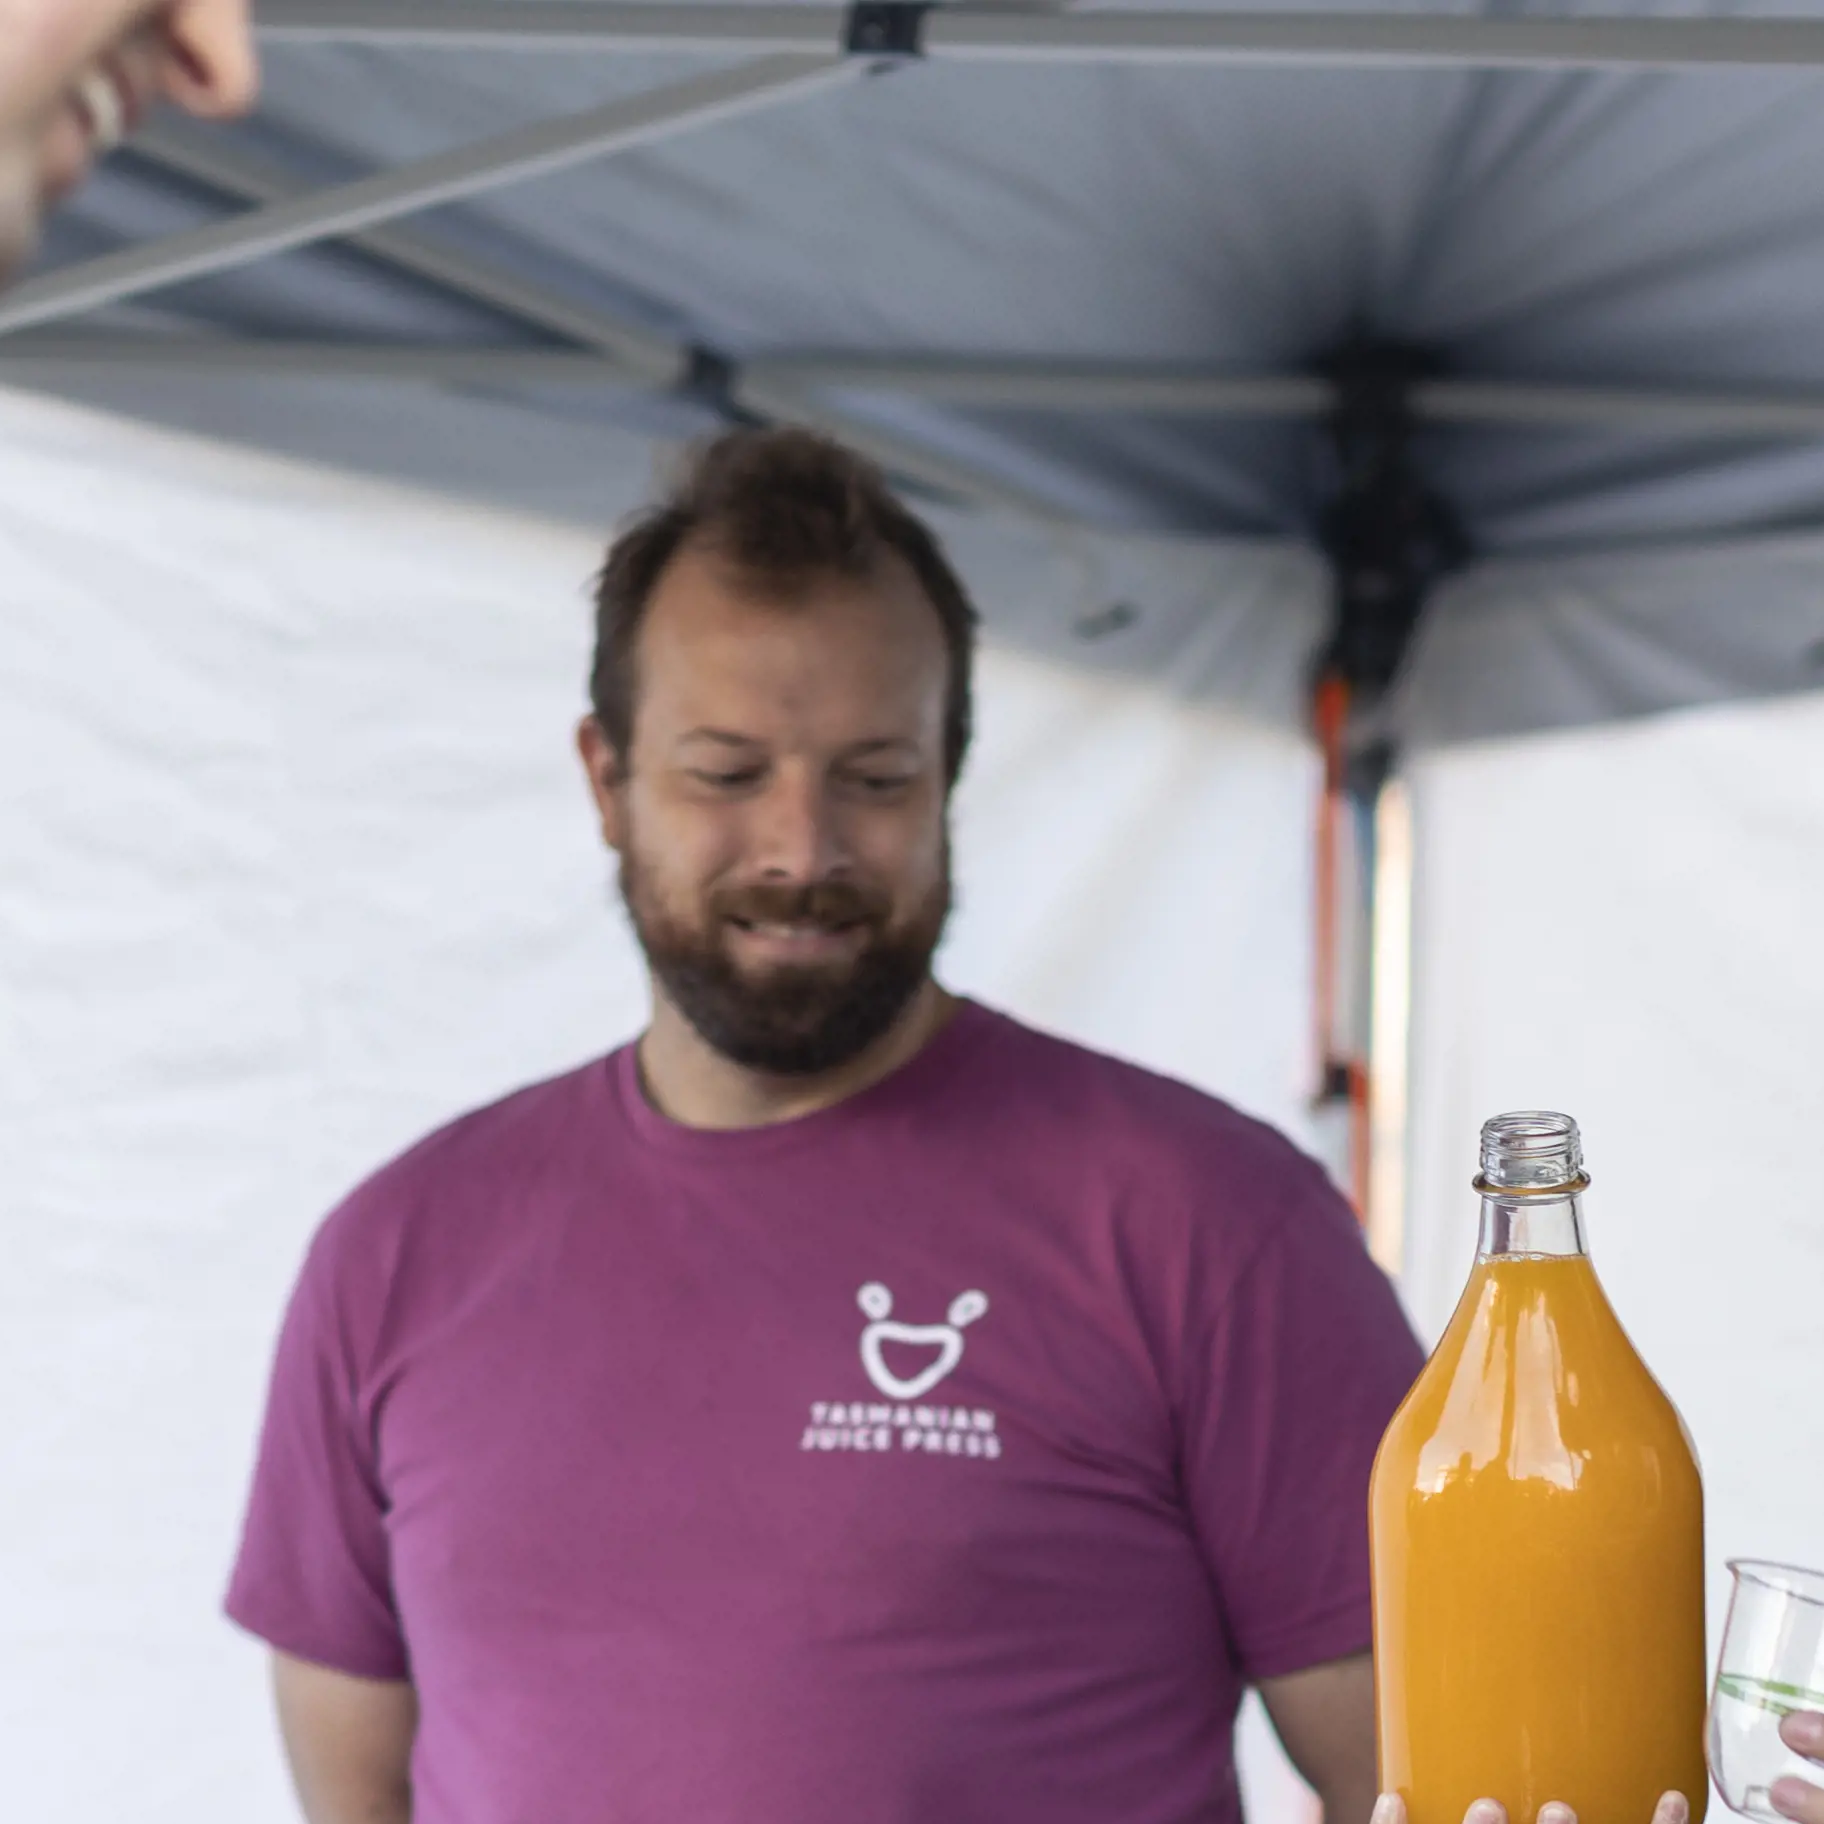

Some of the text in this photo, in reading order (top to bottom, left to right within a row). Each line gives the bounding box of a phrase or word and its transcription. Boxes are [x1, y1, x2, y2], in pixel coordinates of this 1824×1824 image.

[810, 1402, 995, 1431] TASMANIAN
[800, 1427, 1001, 1458] JUICE PRESS
